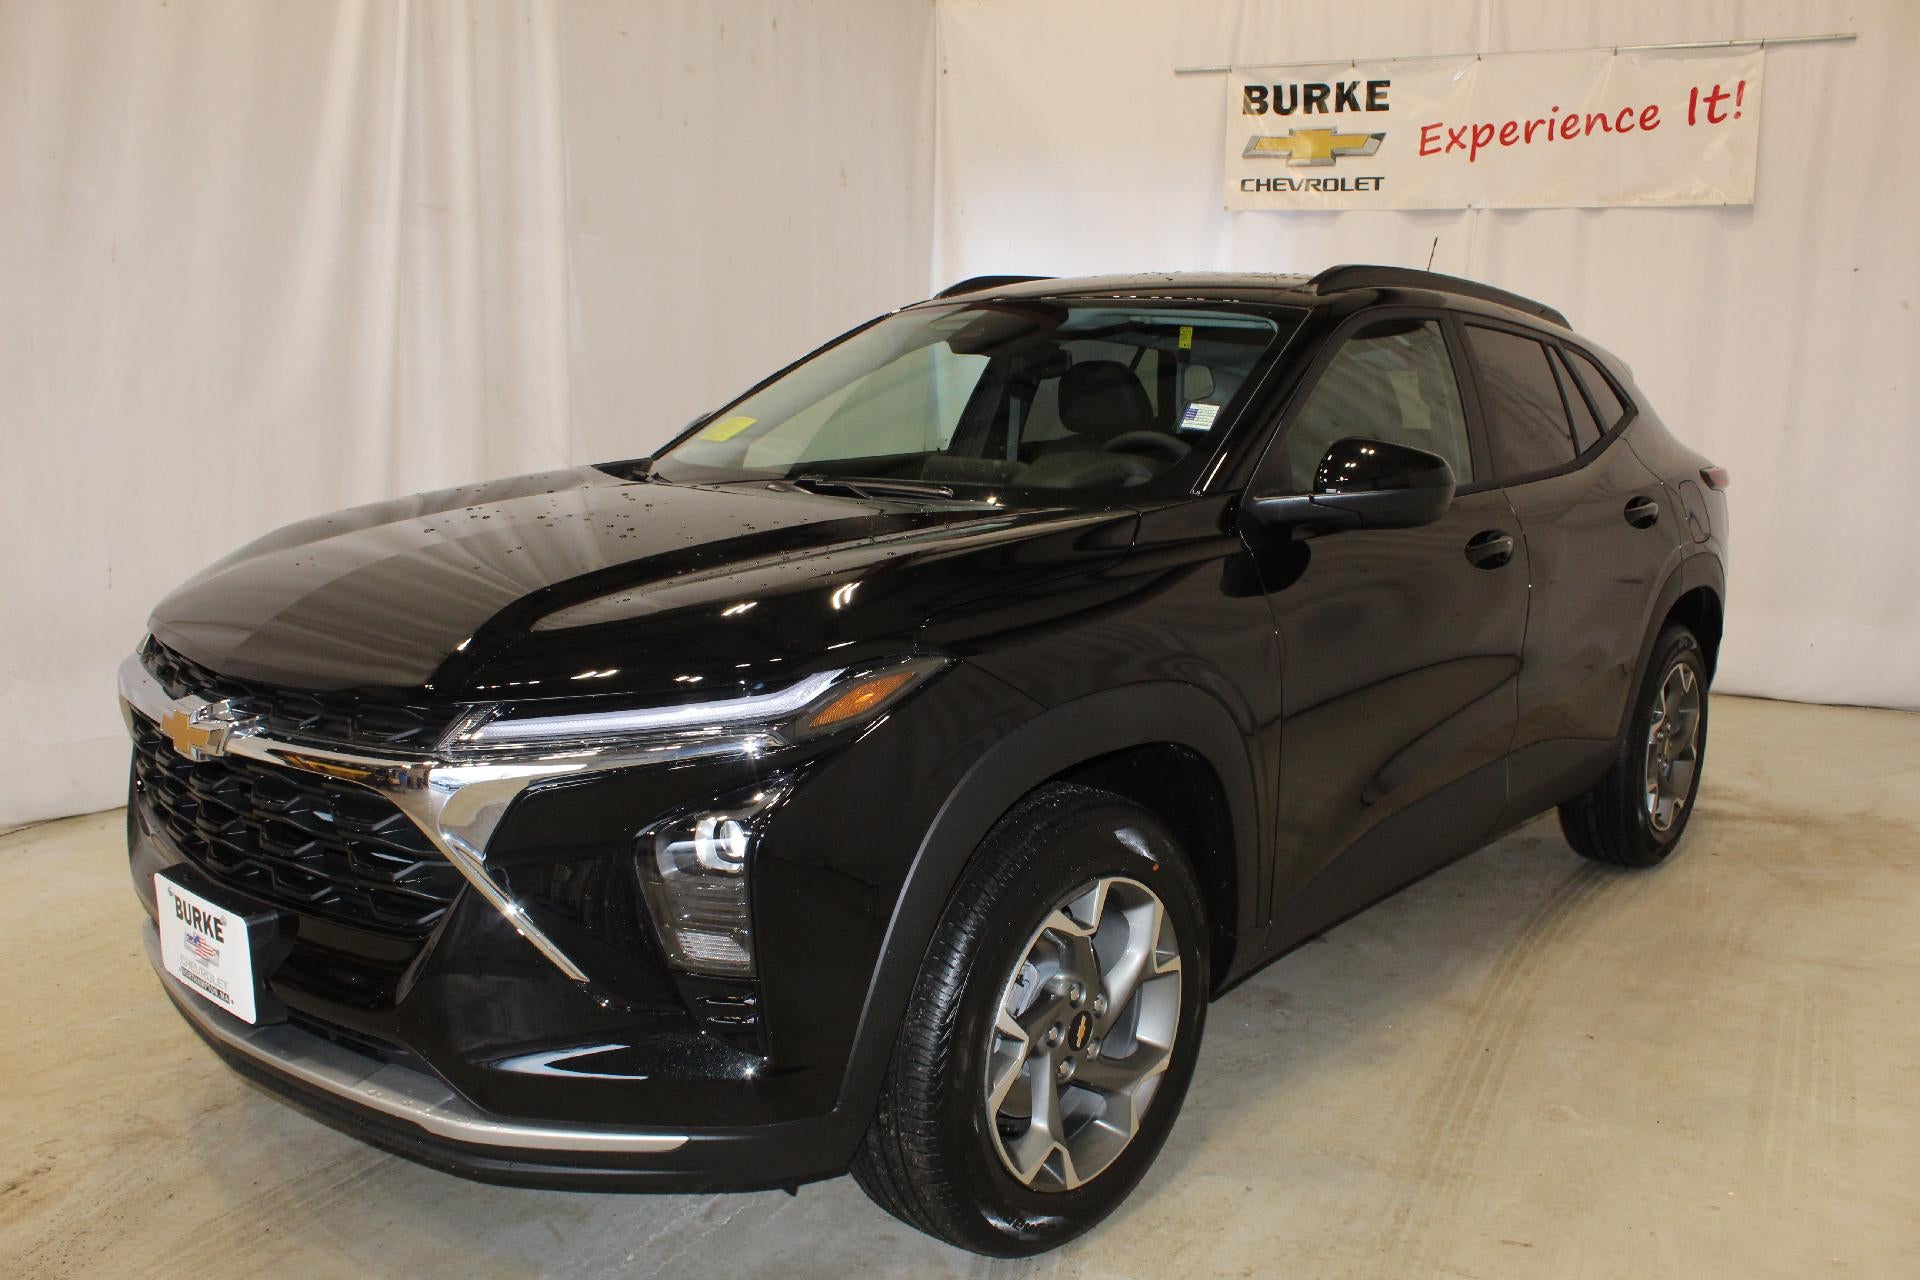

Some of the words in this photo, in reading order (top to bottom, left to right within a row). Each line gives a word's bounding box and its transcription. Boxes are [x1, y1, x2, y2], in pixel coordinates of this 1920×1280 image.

[1243, 80, 1390, 115] BURKE
[1419, 105, 1660, 161] Experience
[1688, 80, 1745, 126] It!
[1241, 177, 1384, 193] CHEVROLET
[175, 896, 224, 943] BURKE
[179, 954, 229, 991] CHEVROLET
